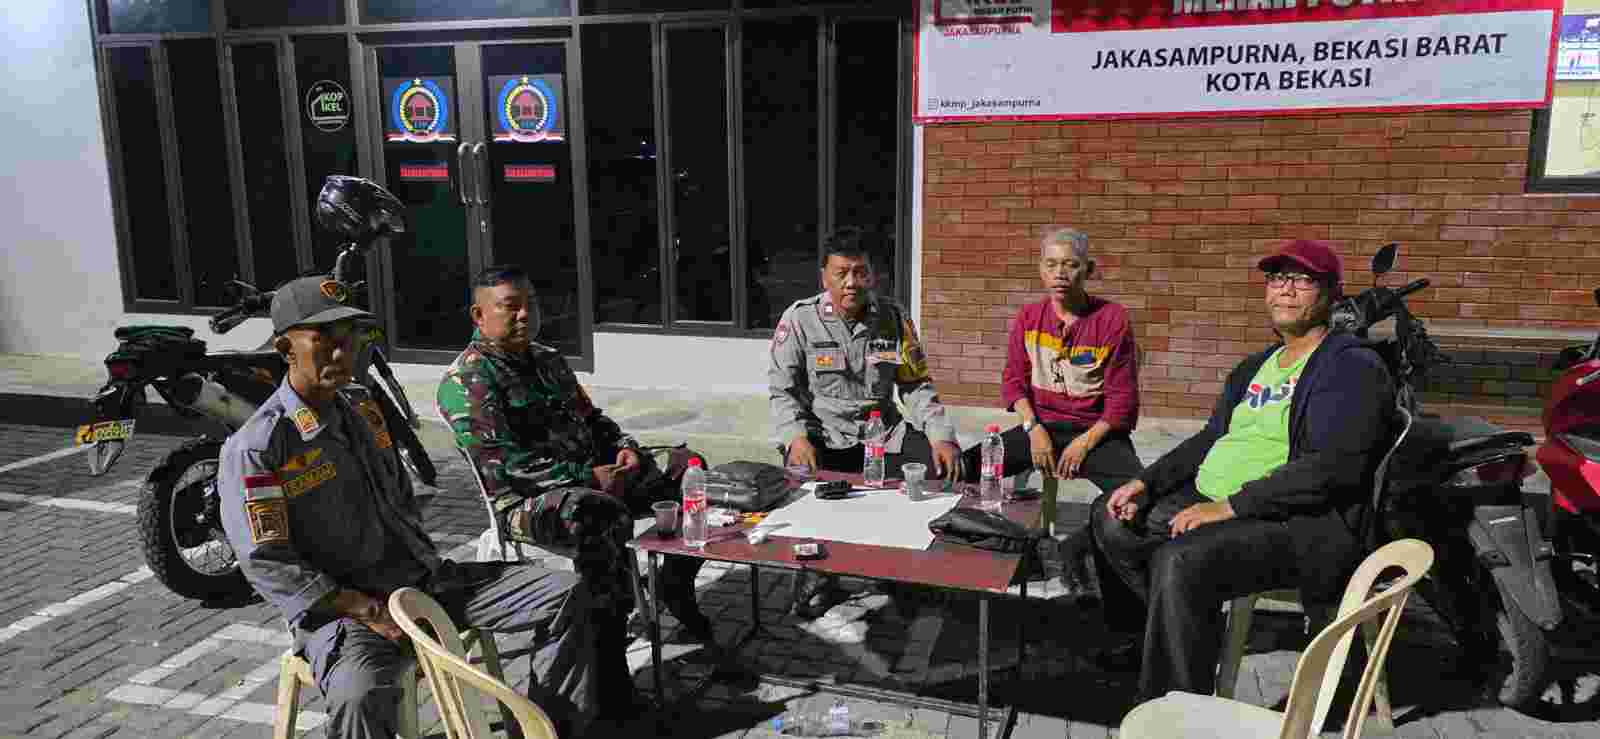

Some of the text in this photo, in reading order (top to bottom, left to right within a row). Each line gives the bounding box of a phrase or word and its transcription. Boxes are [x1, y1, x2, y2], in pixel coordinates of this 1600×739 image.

[1091, 33, 1508, 70] JAKASAMPURNA, BEKASI BARAT
[1206, 67, 1372, 93] KOTA BEKASI
